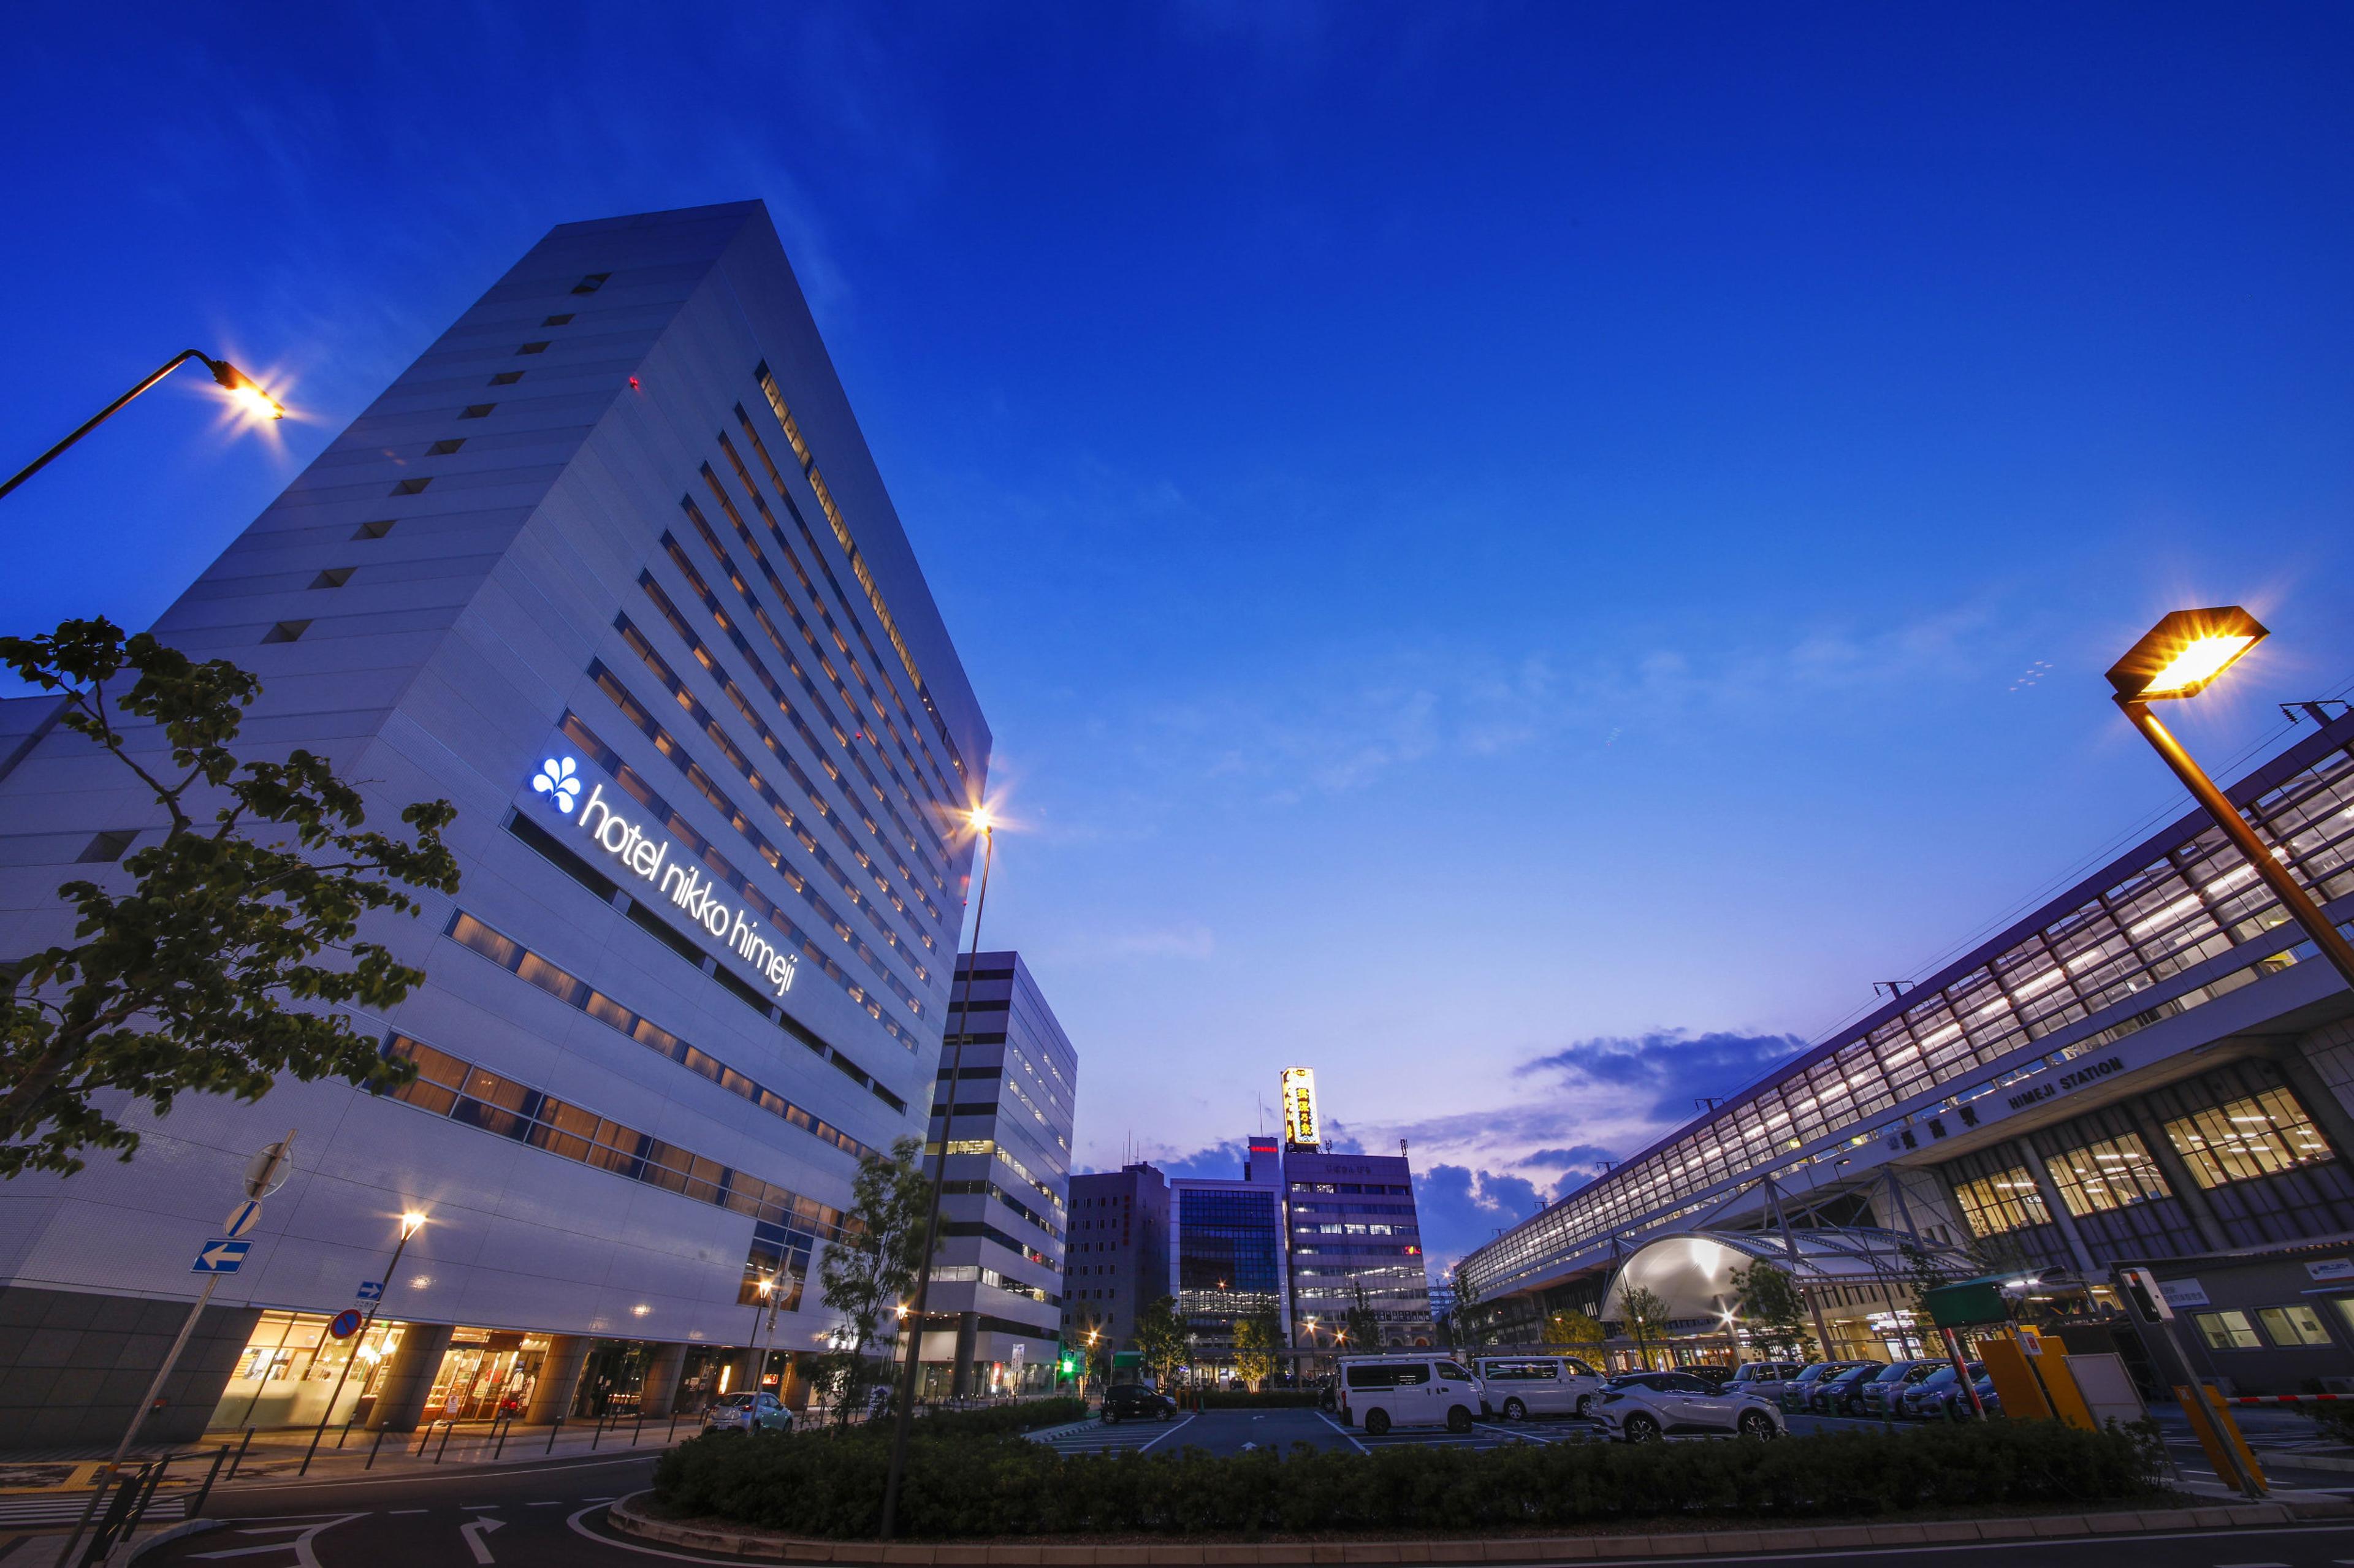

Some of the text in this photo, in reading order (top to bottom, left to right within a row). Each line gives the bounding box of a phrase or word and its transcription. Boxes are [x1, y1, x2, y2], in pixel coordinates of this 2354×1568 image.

[579, 784, 798, 996] hotel nikko himeji
[2008, 1057, 2124, 1110] HIMEJI STATION
